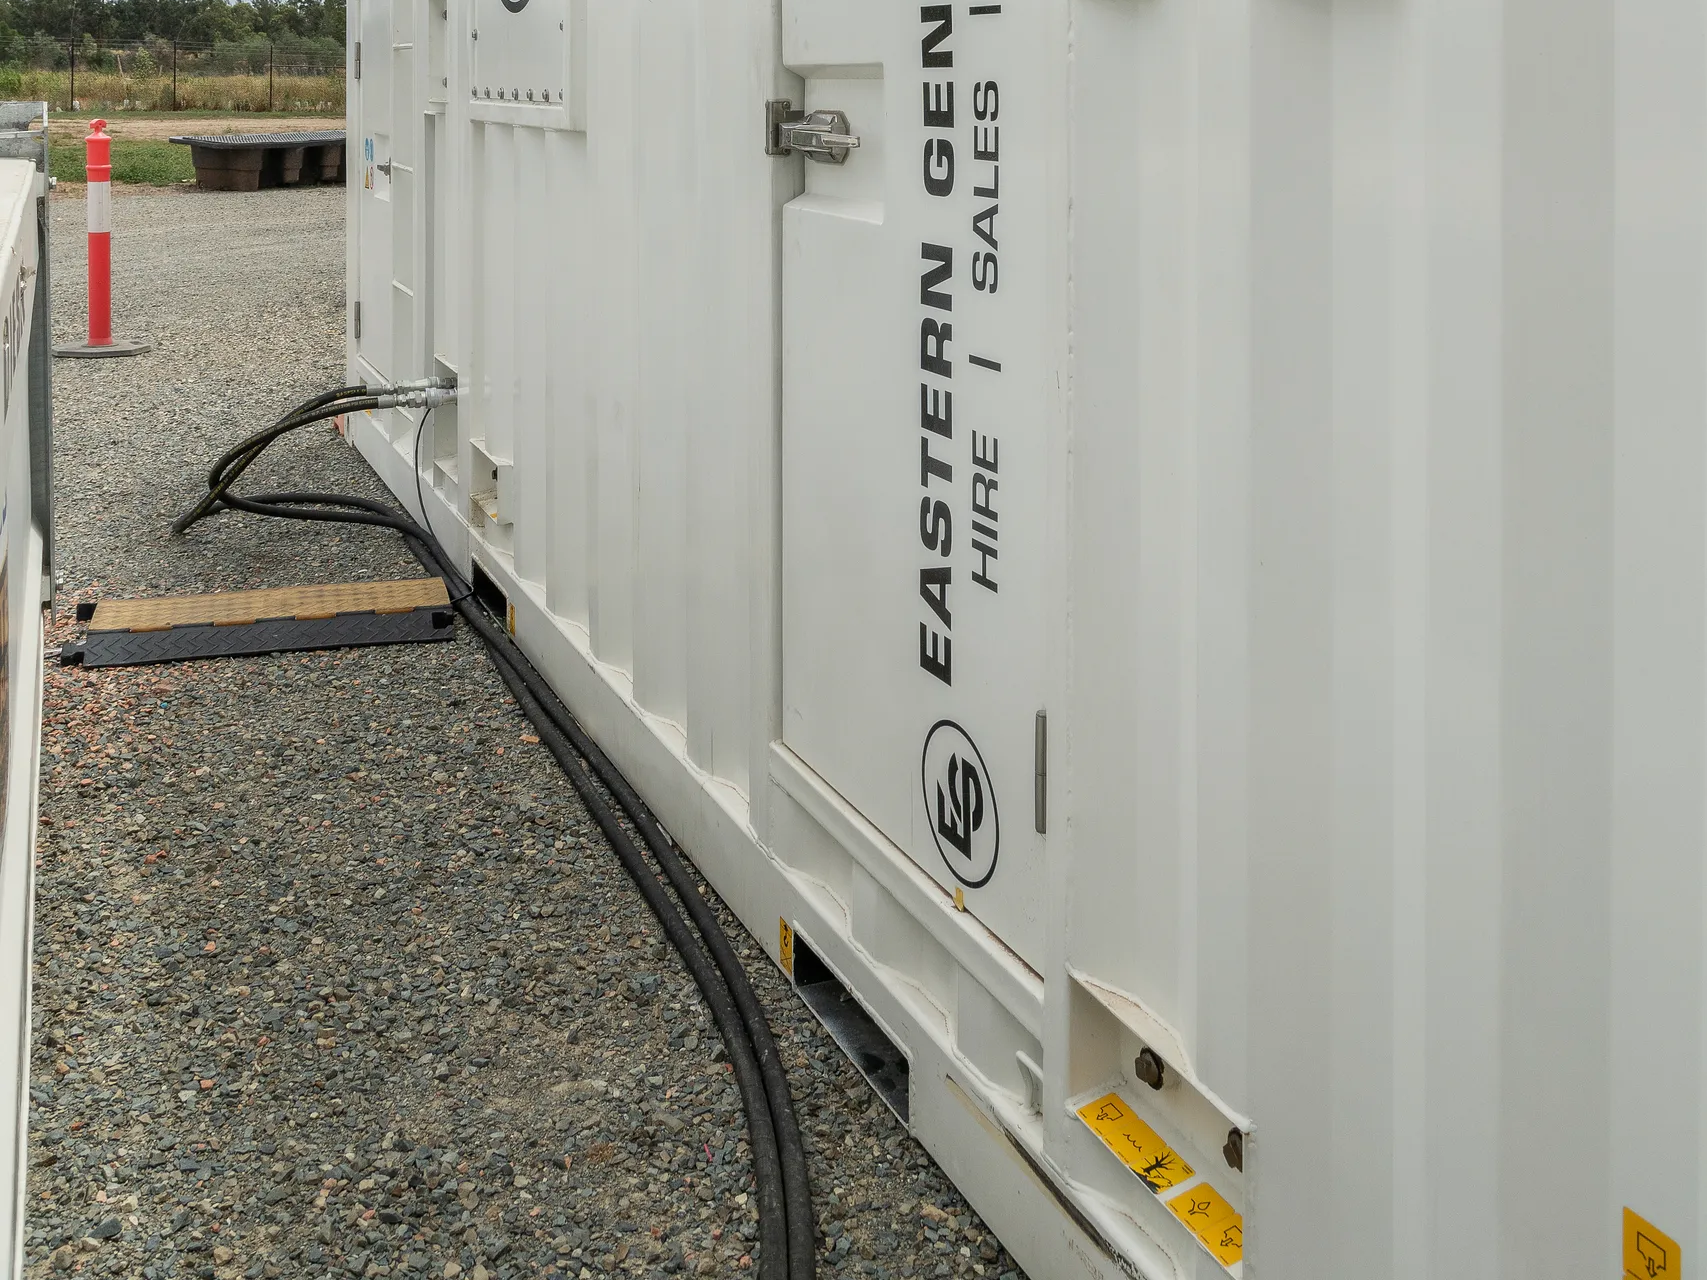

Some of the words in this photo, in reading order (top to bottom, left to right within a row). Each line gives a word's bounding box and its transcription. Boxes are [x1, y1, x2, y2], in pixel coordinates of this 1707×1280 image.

[972, 80, 999, 294] SALES
[919, 241, 953, 687] EASTERN
[971, 429, 999, 594] HIRE
